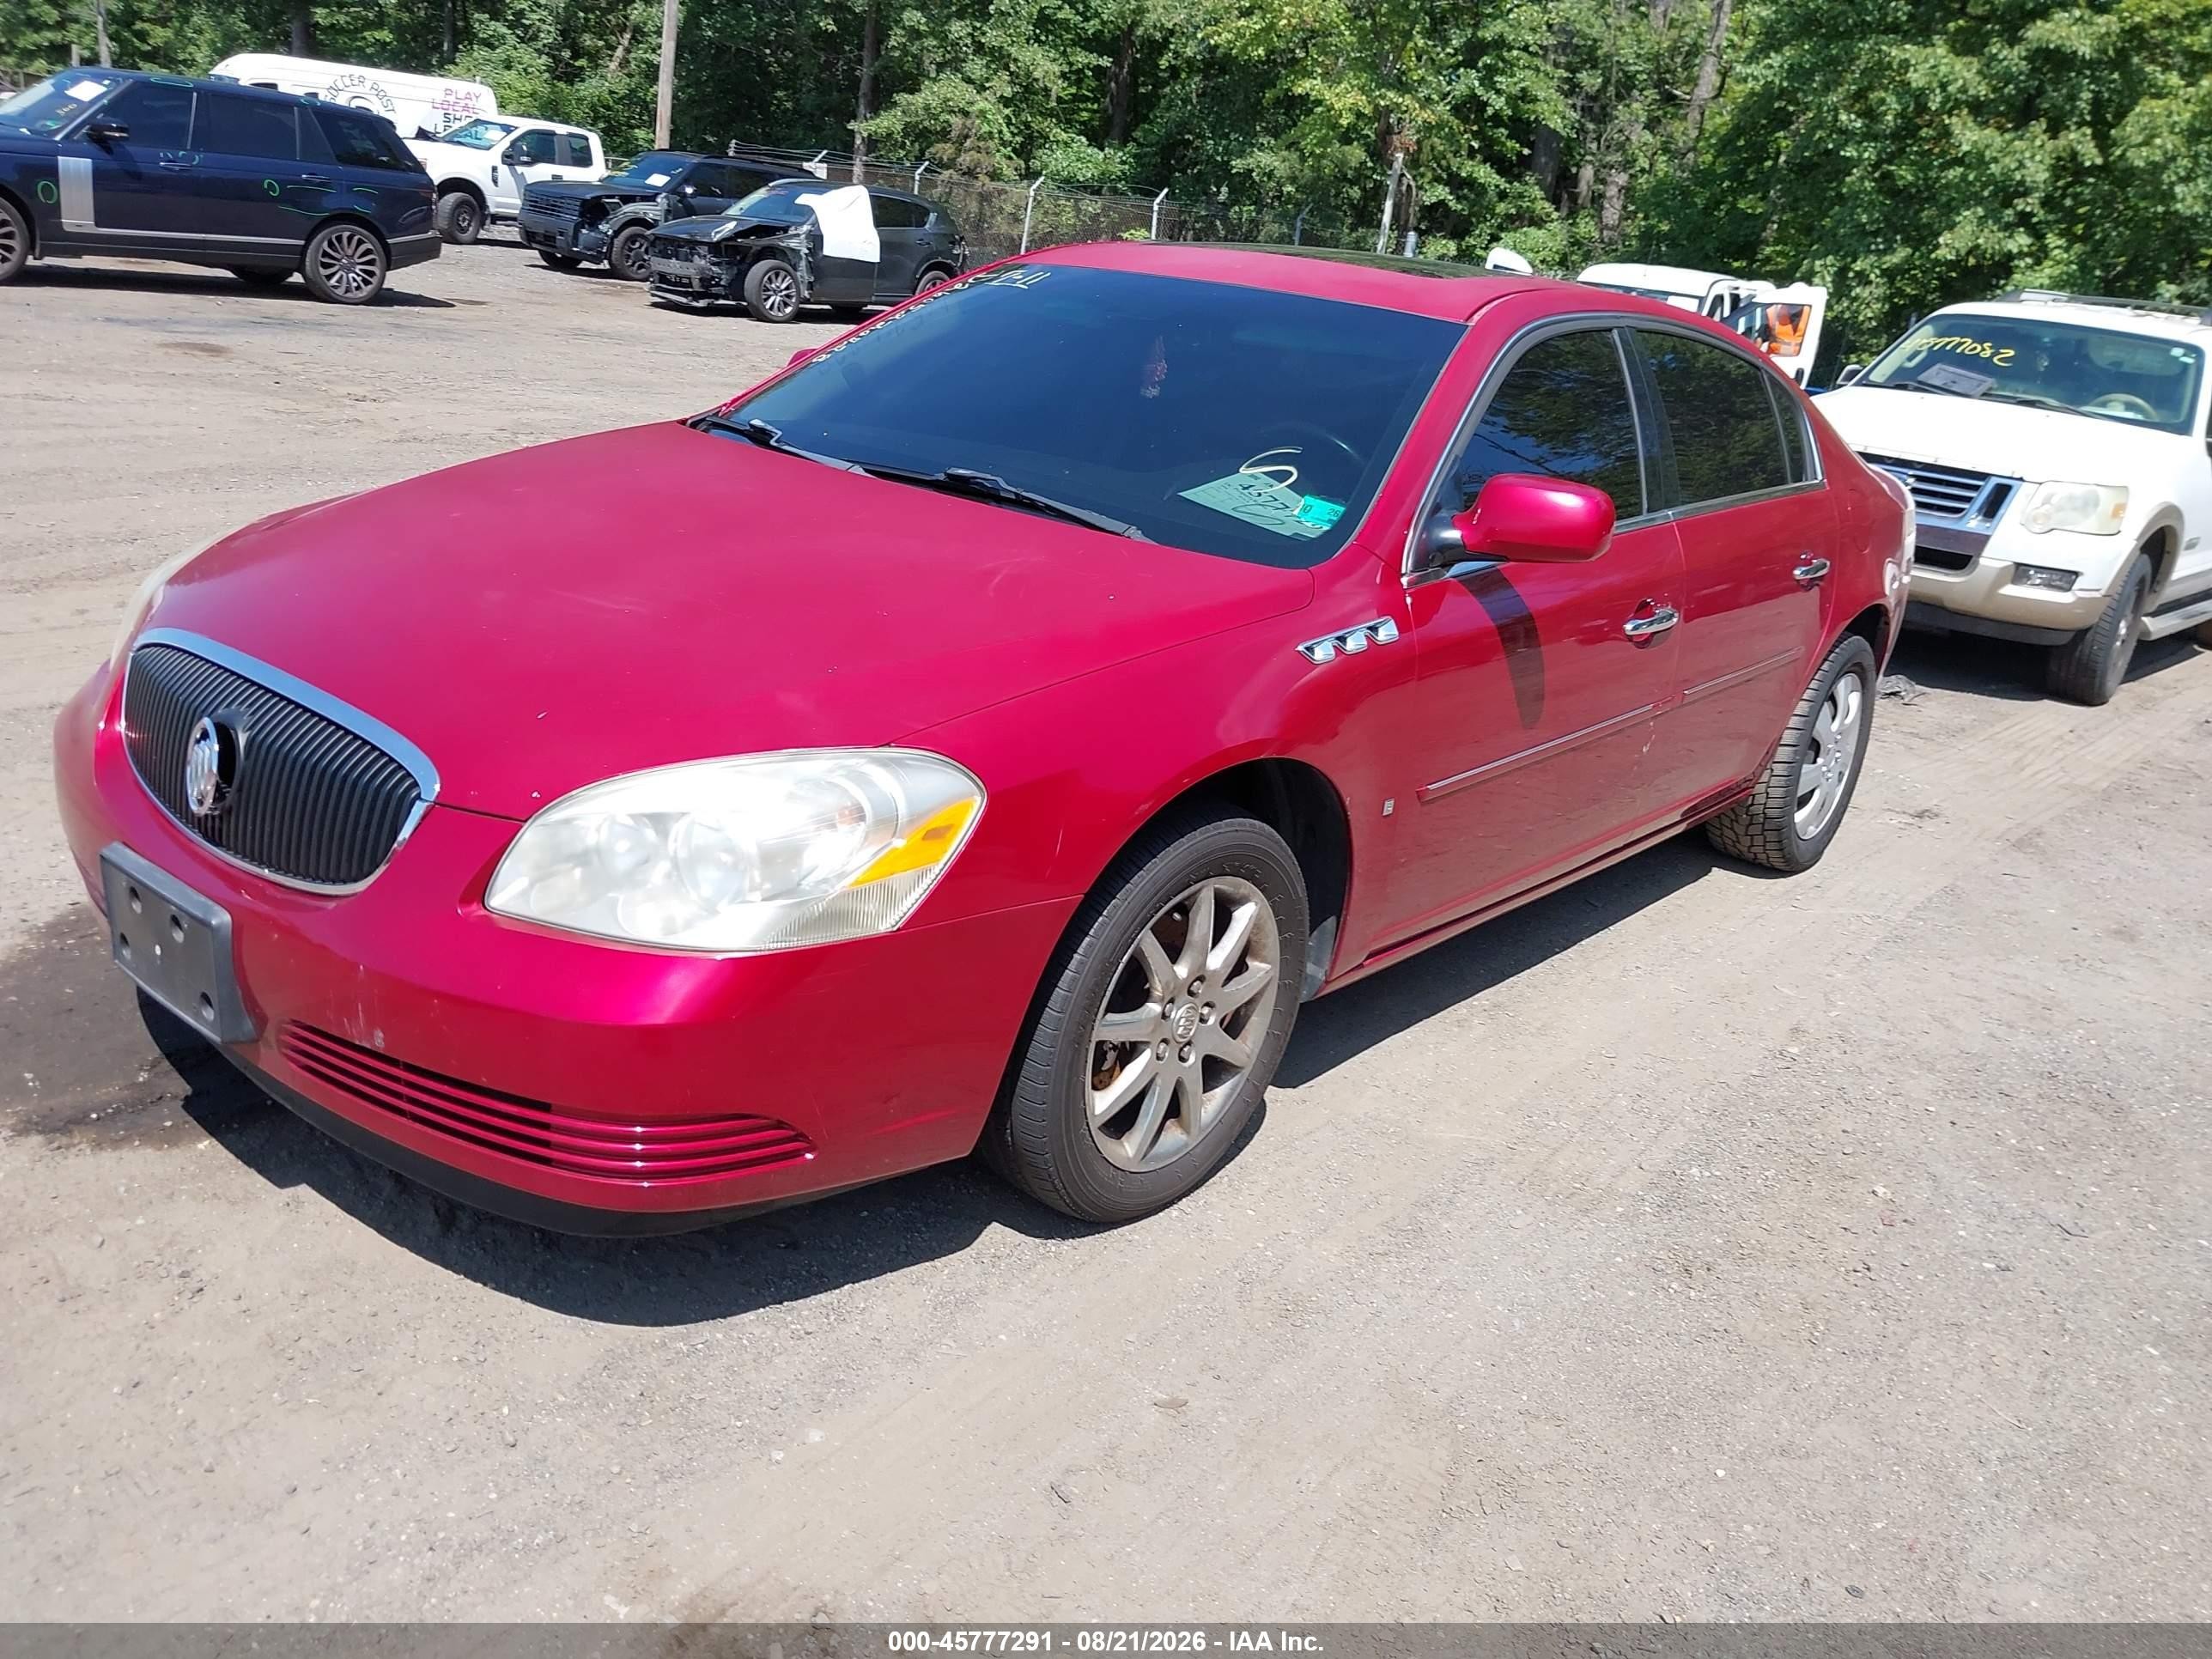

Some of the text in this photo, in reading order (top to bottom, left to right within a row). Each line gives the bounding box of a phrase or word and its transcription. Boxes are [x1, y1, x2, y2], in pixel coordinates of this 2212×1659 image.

[369, 82, 397, 113] POST
[443, 88, 482, 102] PLAY
[431, 98, 480, 115] LOCAL
